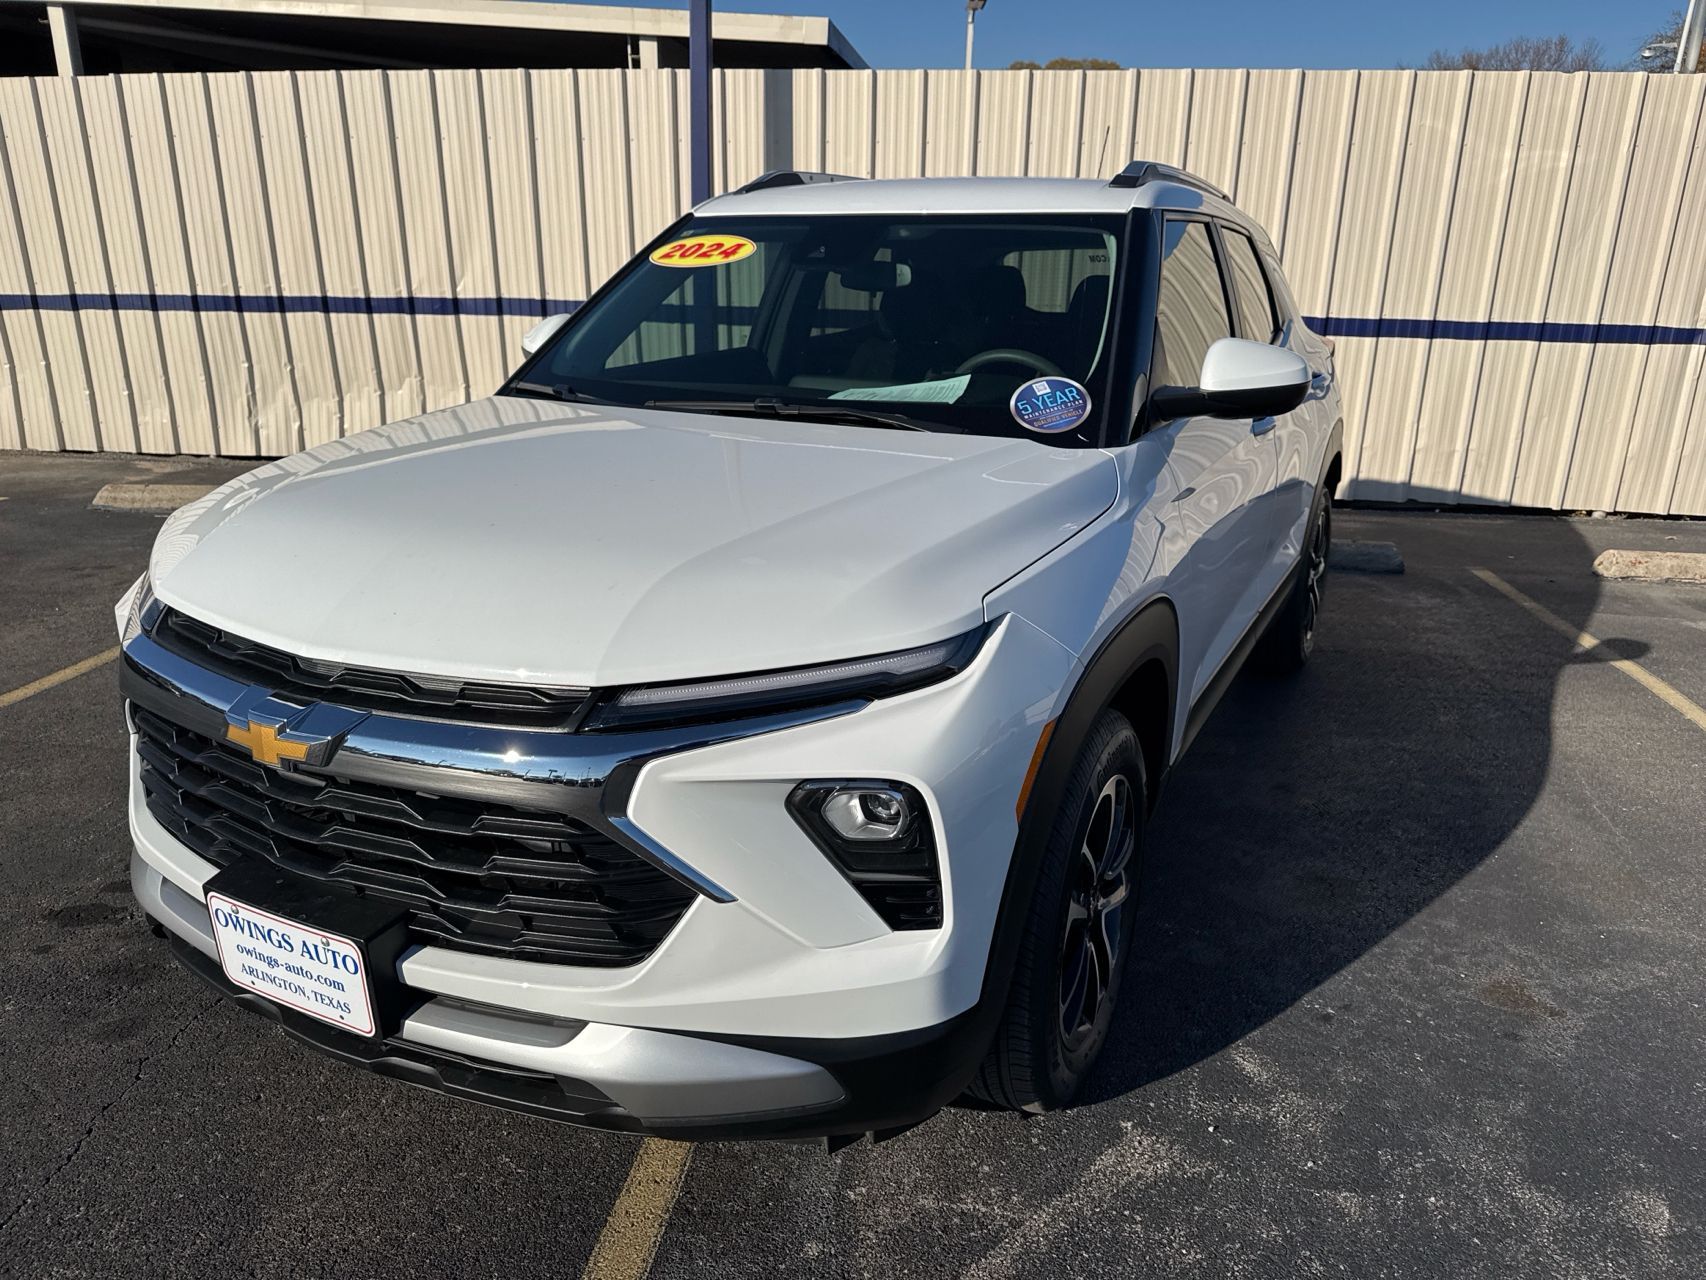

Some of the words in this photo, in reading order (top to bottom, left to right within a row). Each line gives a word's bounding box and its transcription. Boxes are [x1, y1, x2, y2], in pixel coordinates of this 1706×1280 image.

[658, 242, 748, 259] 2024
[1017, 400, 1032, 415] 5
[1031, 387, 1081, 410] YEAR
[214, 907, 295, 953] OWINGS
[300, 939, 359, 975] AUTO
[236, 944, 346, 993] owings-auto.com
[240, 962, 311, 1000] ARLINGTON,
[311, 990, 351, 1015] TEXAS
